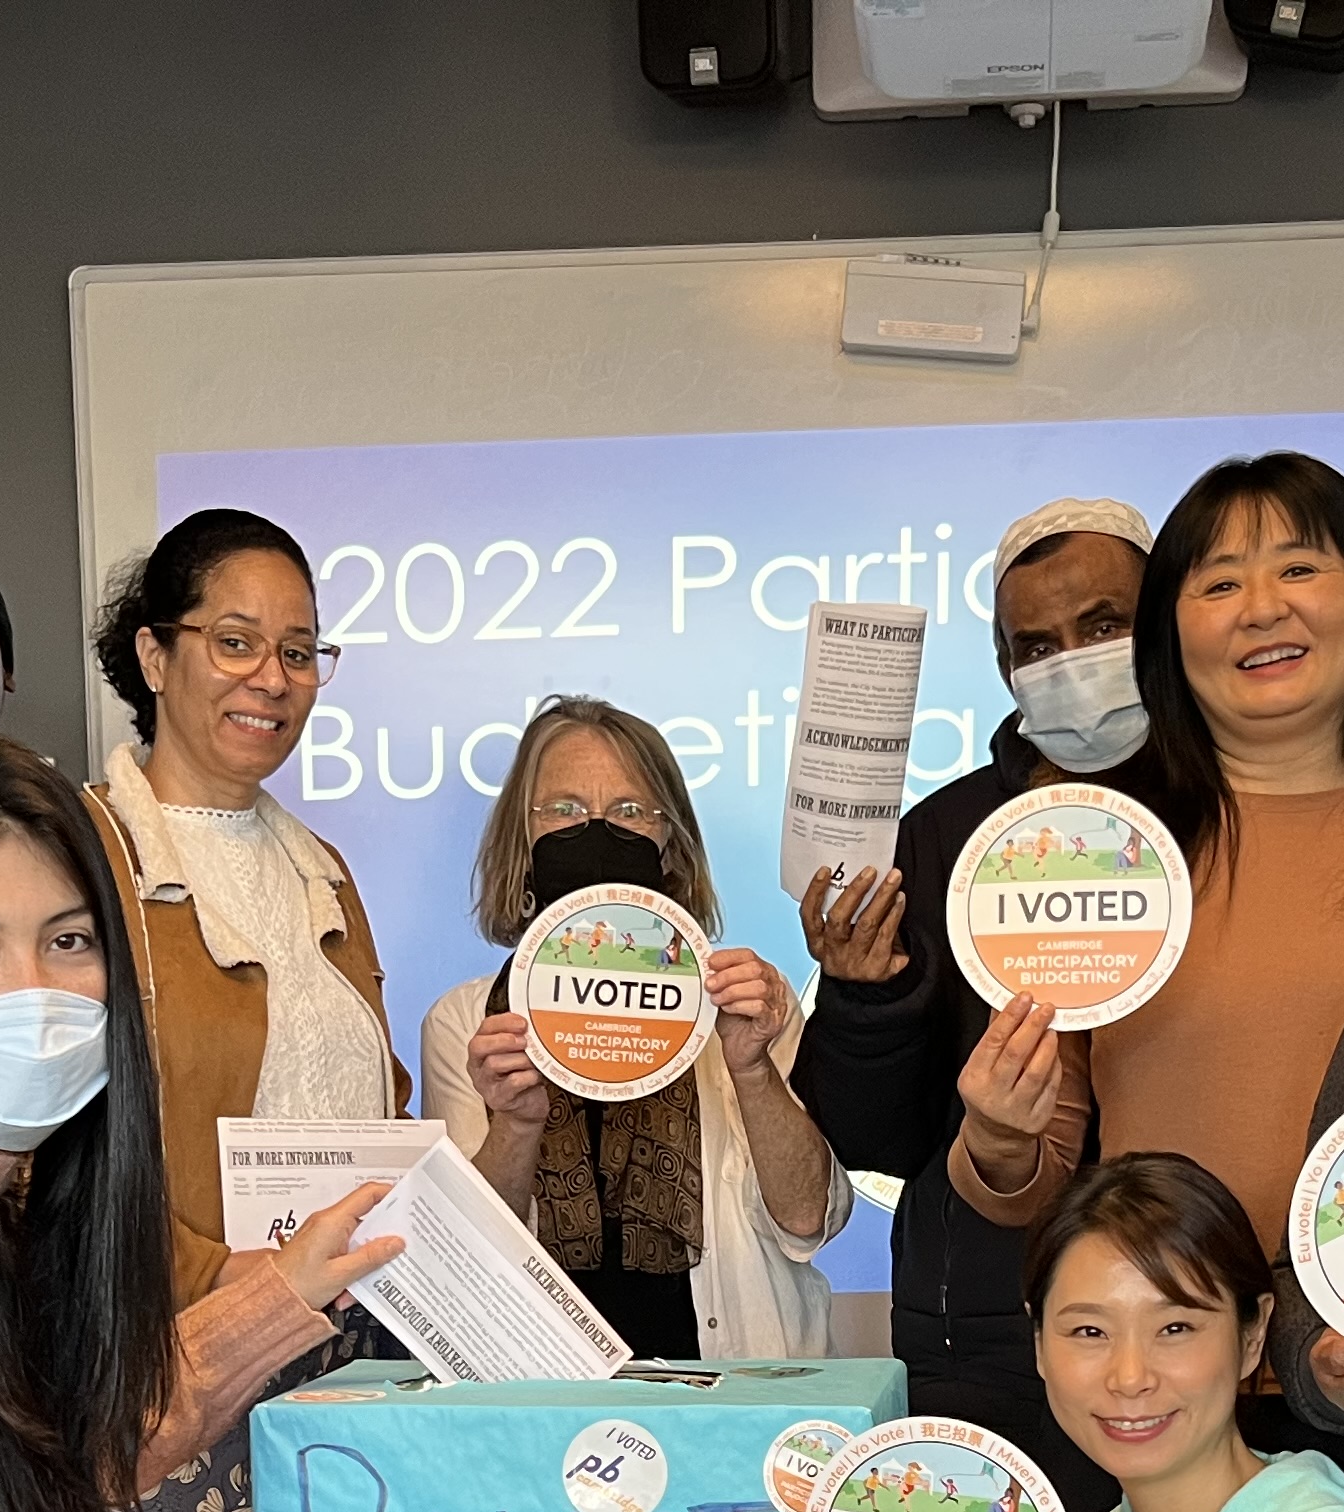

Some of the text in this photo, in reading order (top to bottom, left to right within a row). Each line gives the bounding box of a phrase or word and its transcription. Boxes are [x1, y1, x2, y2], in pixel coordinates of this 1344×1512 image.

[987, 64, 1045, 74] EPSON
[318, 536, 620, 644] 2022
[825, 617, 857, 637] WHAT
[857, 622, 868, 639] IS
[795, 794, 814, 811] FOR
[818, 800, 847, 818] MORE
[998, 890, 1148, 924] I VOTED
[1037, 940, 1103, 951] CAMBRIDGE
[1003, 954, 1139, 971] PARTICIPATORY
[1020, 971, 1121, 985] BUDGETING
[553, 975, 682, 1011] I VOTED
[585, 1021, 641, 1034] CAMBRIDGE
[555, 1032, 671, 1051] PARTICIPATORY
[568, 1046, 654, 1064] BUDGETING
[232, 1151, 252, 1166] FOR
[256, 1151, 284, 1166] MORE
[1306, 1166, 1323, 1184] Yo
[267, 1209, 297, 1241] pb
[372, 1273, 434, 1336] BUDGETING?
[521, 1255, 618, 1360] ACKNOWLEDGEMENTS
[606, 1427, 657, 1460] I VOTED
[849, 1443, 870, 1458] Yo
[565, 1454, 625, 1483] pb
[786, 1455, 794, 1468] I
[996, 1448, 1036, 1488] Mwen
[1036, 1486, 1050, 1506] Te
